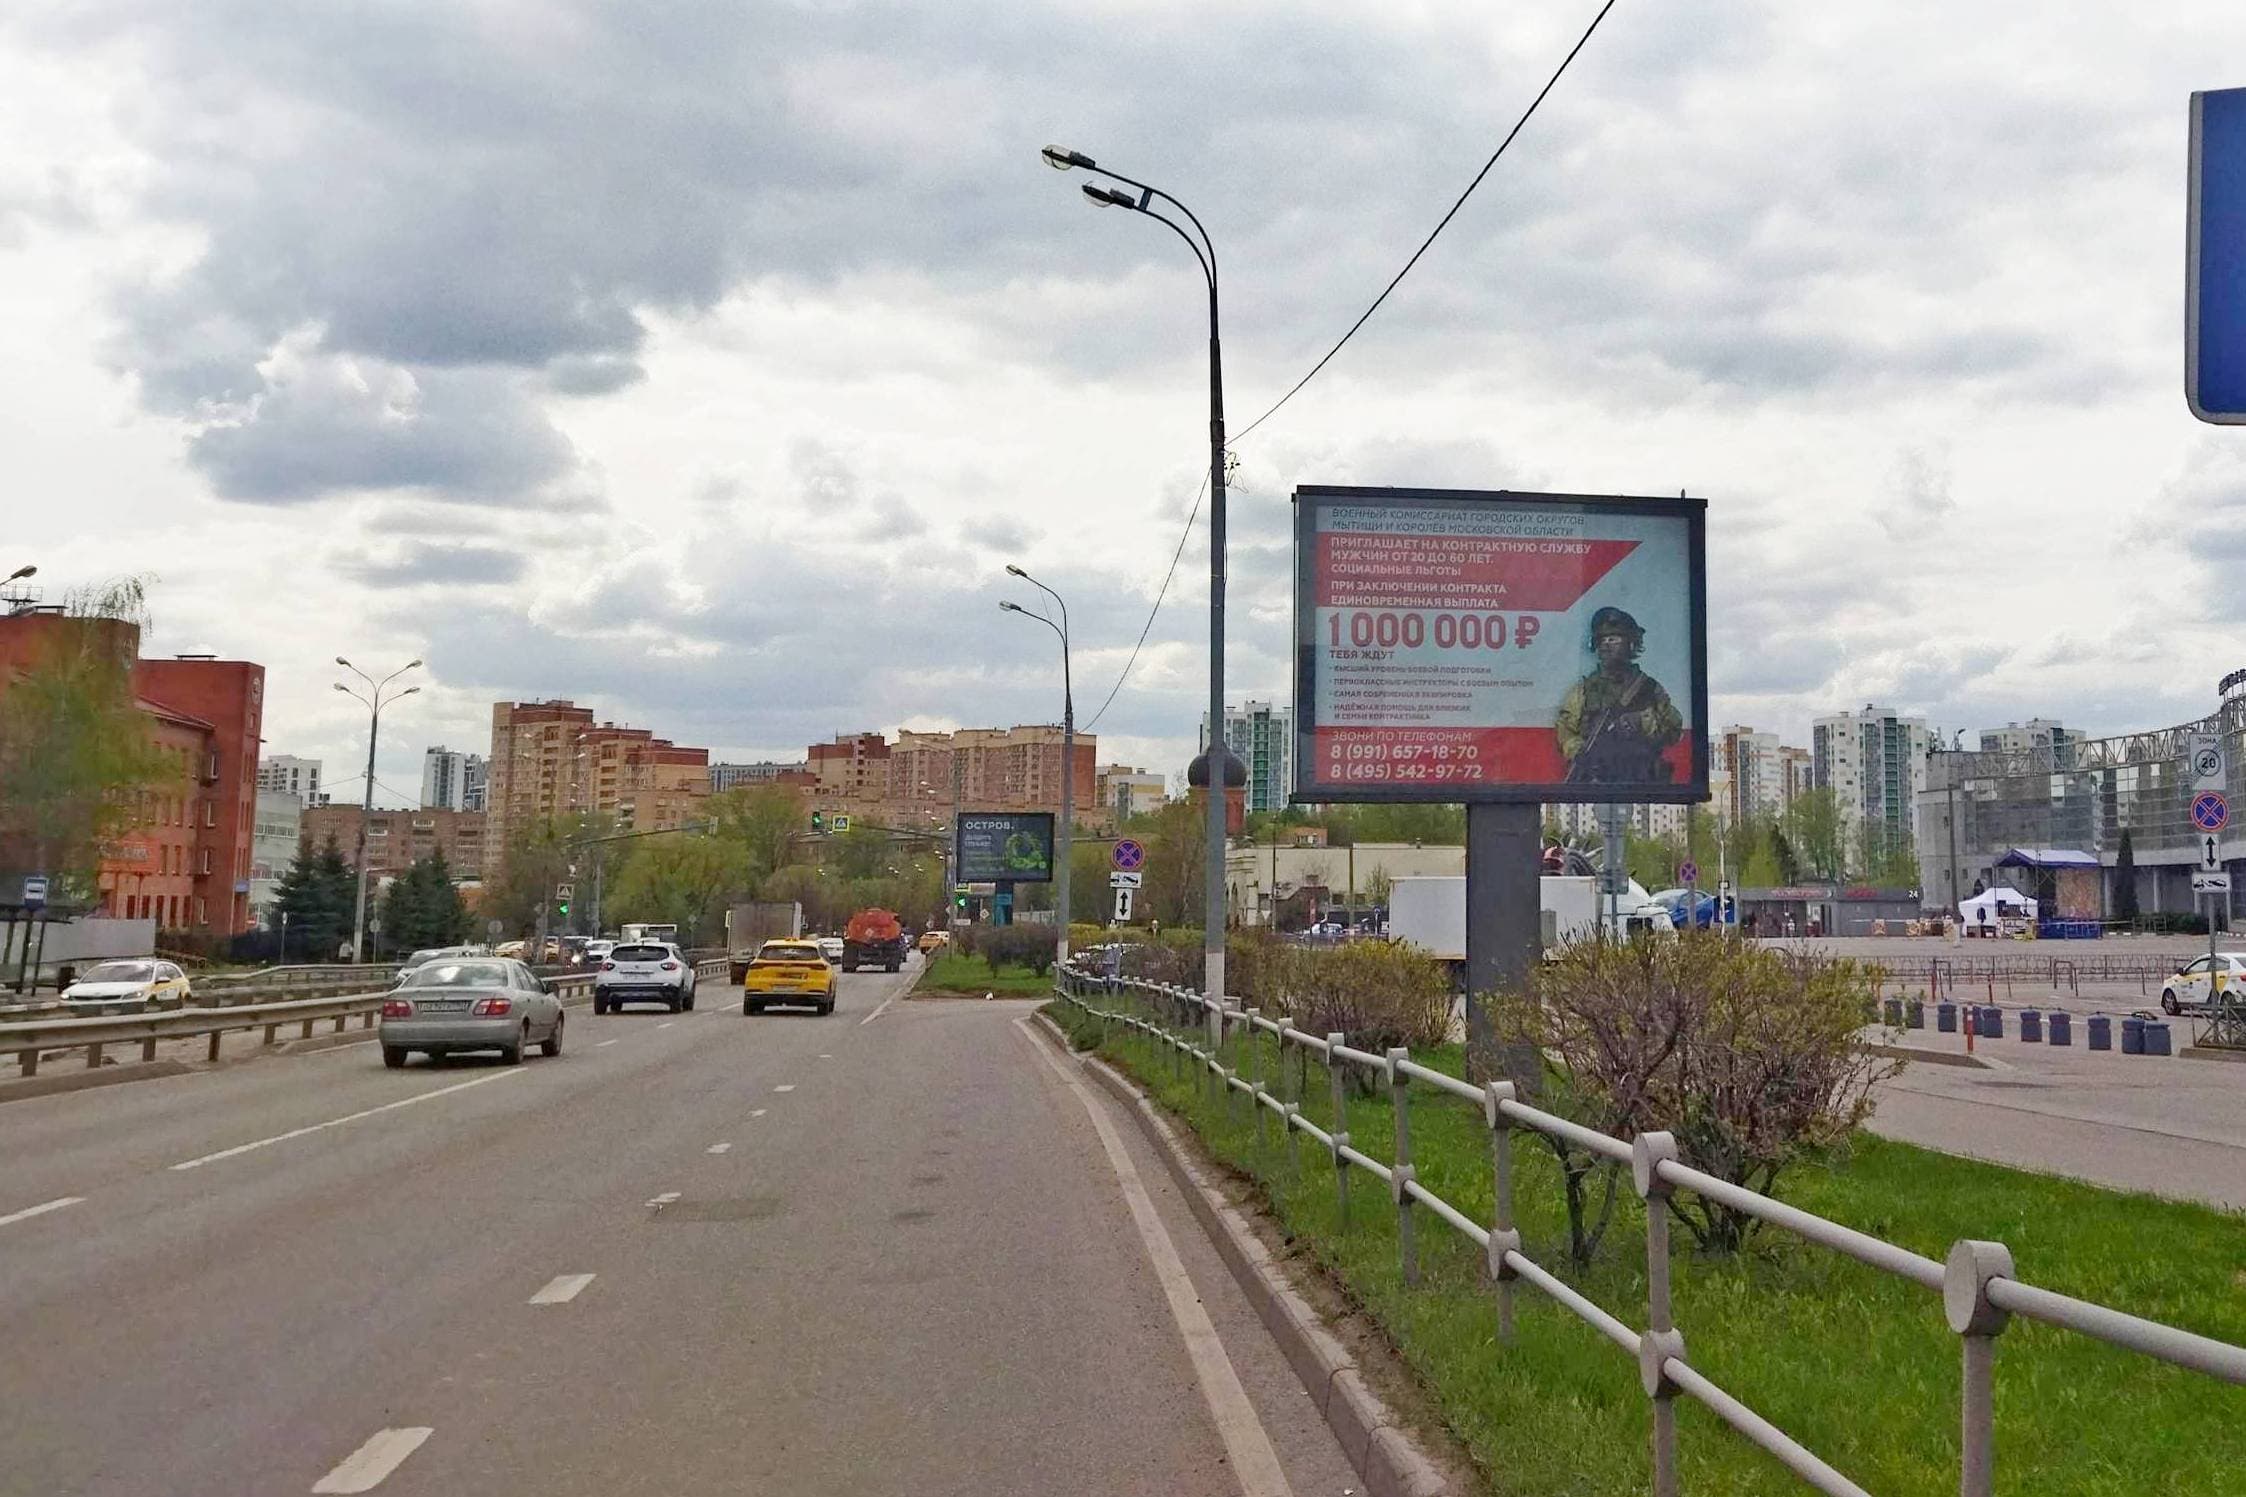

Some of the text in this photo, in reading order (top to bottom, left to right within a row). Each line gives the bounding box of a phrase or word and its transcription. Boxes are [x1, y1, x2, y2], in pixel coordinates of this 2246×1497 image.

[1332, 508, 1585, 525] ВОЕННЫЙ КОМИССАРИАТ ГОРОДСКИХ ОКРУГОВ
[1332, 520, 1383, 531] МЫТИЩИ
[1387, 522, 1393, 530] И
[1449, 524, 1520, 535] МОСКОВСКОЙ
[1524, 526, 1574, 537] ОБЛАСТИ
[1331, 537, 1592, 554] ПРИГЛАШАЕТ НА КОНТРАКТНУЮ СЛУЖБУ
[1331, 550, 1494, 564] МУЖЧИН ОТ 20 ДО 60 ЛЕТ.
[1331, 564, 1461, 576] СОЦИАЛЬНЫЕ ЛЬГОТЫ
[1331, 581, 1508, 594] ПРИ ЗАКЛЮЧЕНИИ КОНТРАКТА
[1331, 595, 1499, 608] ЕДИНОВРЕМЕННАЯ ВЫПЛАТА
[1328, 612, 1340, 647] 1
[1350, 612, 1425, 648] 000
[1434, 614, 1507, 649] 000
[1329, 650, 1395, 660] ТЕБЯ ЖДУТ
[1332, 731, 1472, 742] ЗВОНИ ПО ТЕЛЕФОНАМ
[1331, 744, 1478, 760] 8 (991) 657-18-70
[2202, 757, 2216, 768] 20
[1331, 763, 1483, 779] 8 (495) 542-97-72
[1909, 890, 1918, 899] 24
